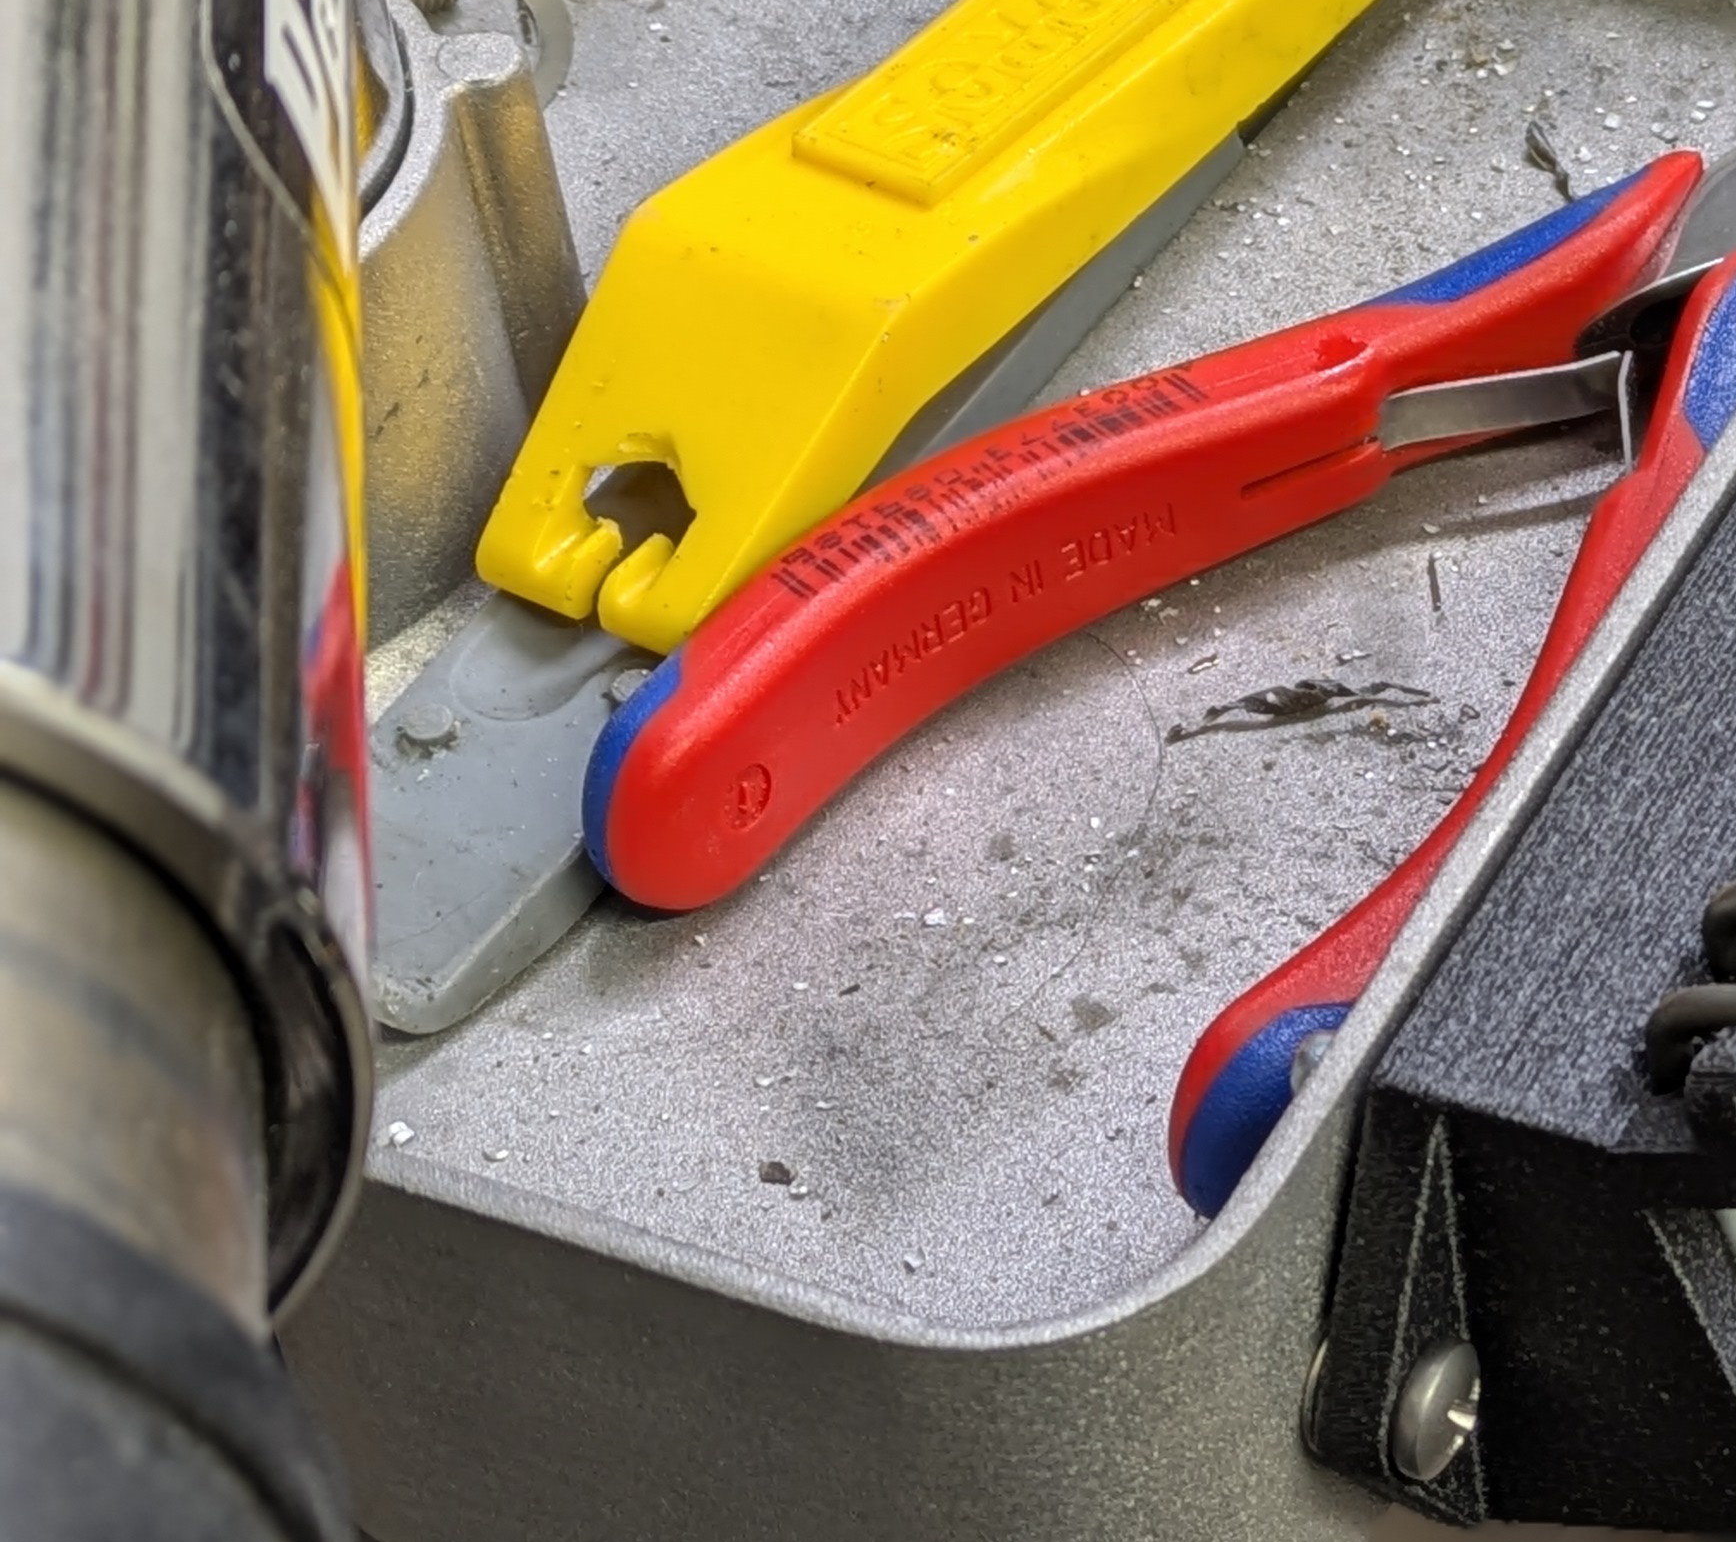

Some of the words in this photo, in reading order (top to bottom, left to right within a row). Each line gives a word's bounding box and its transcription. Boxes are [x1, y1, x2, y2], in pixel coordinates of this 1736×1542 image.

[1008, 559, 1045, 603] IN
[1061, 502, 1177, 581] MADE
[834, 585, 993, 728] GERMANY
